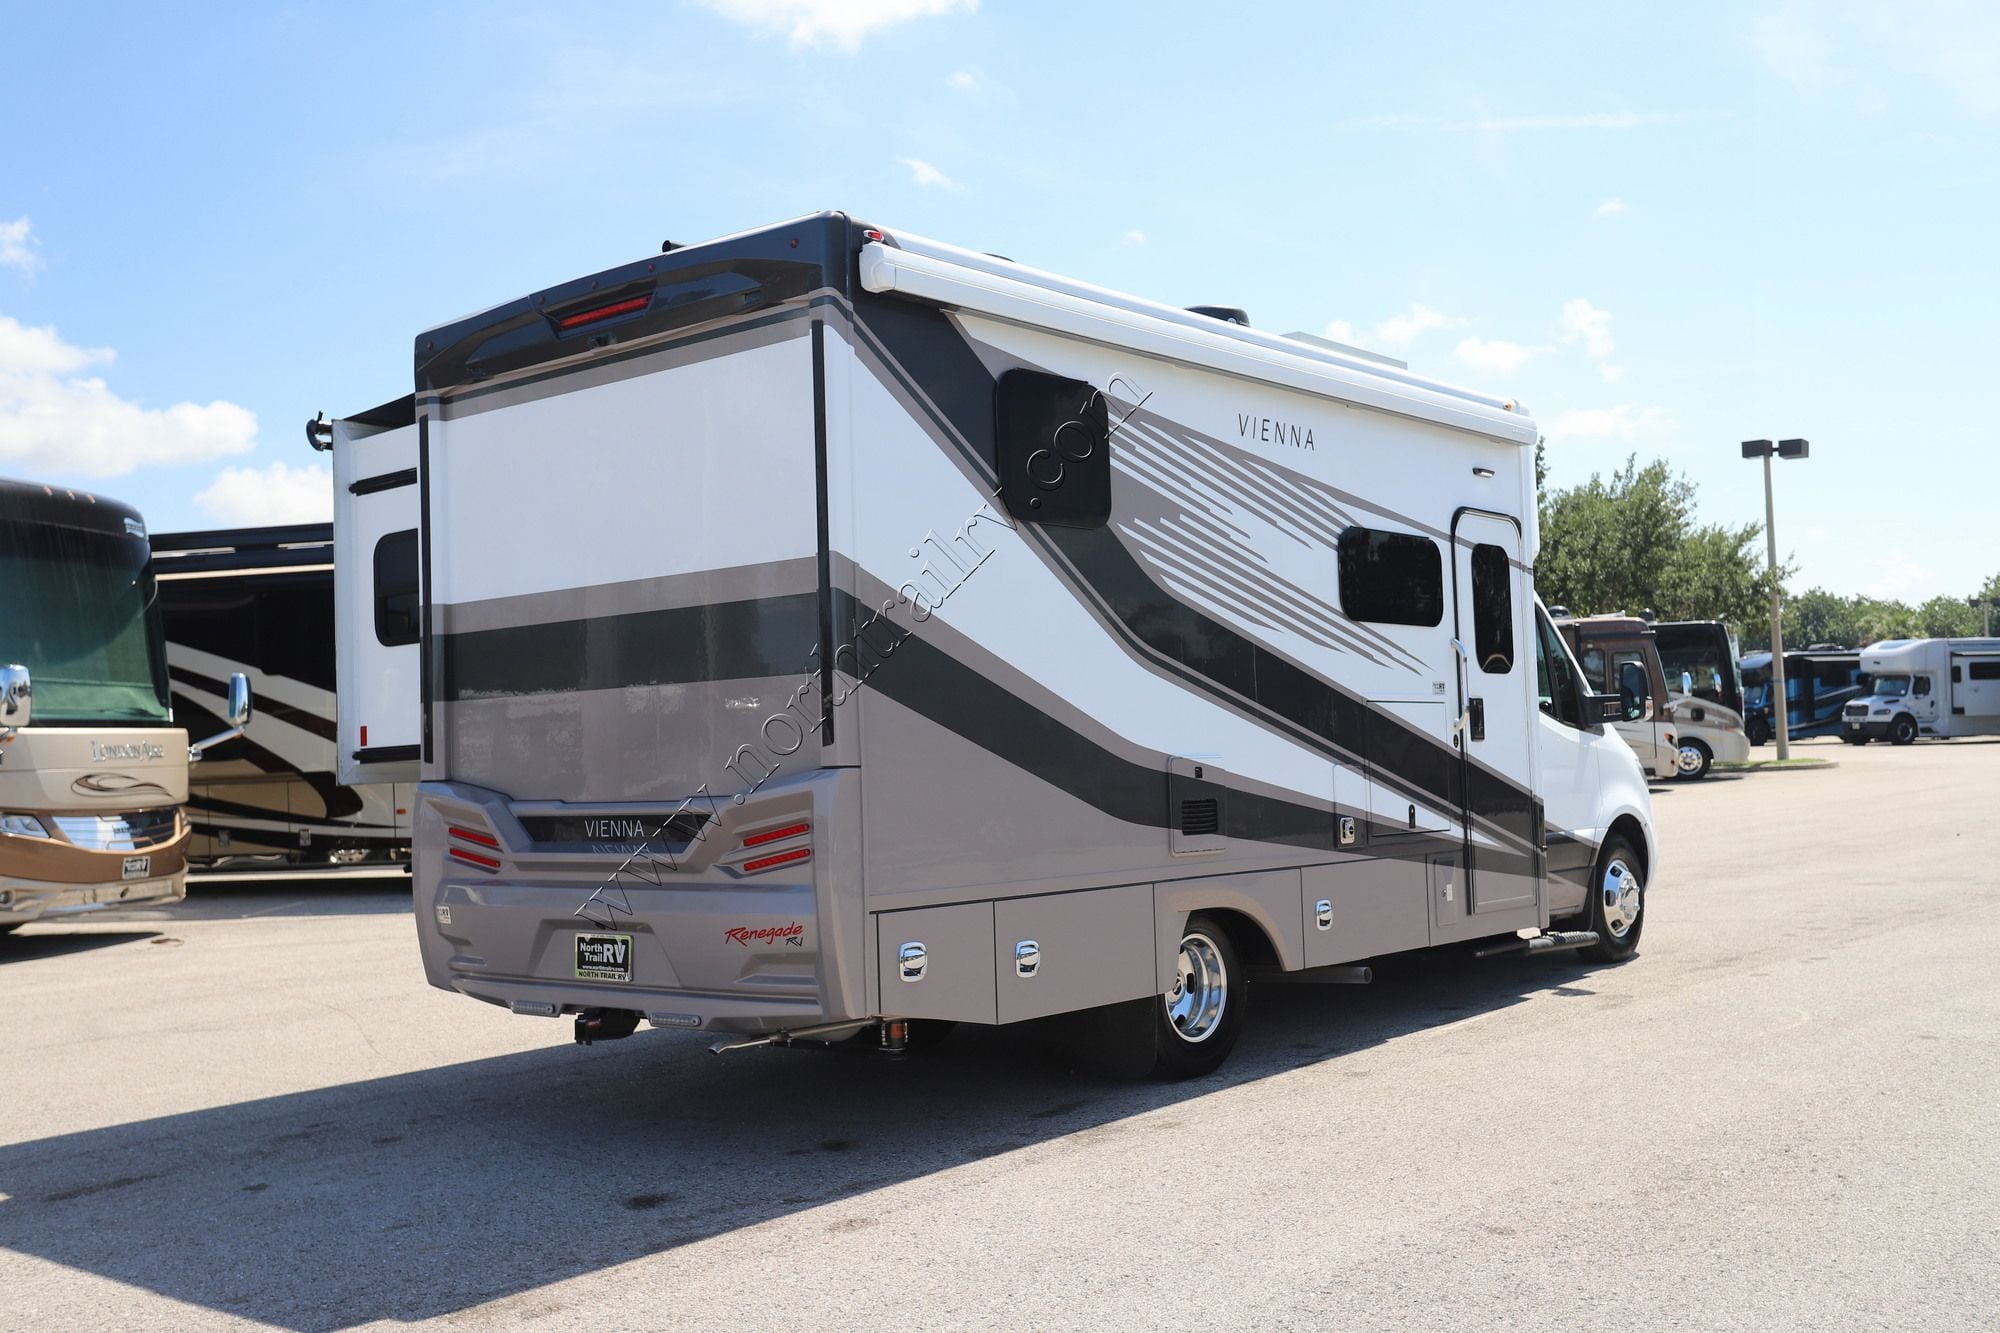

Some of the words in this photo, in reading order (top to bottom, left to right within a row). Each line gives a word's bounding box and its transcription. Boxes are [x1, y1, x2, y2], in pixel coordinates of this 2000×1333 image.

[1238, 413, 1315, 451] VIENNA
[584, 819, 645, 838] VIENNA
[725, 922, 803, 947] Renegade
[785, 936, 804, 947] RV
[580, 942, 602, 952] North
[603, 943, 626, 963] RV
[584, 952, 602, 962] Trail
